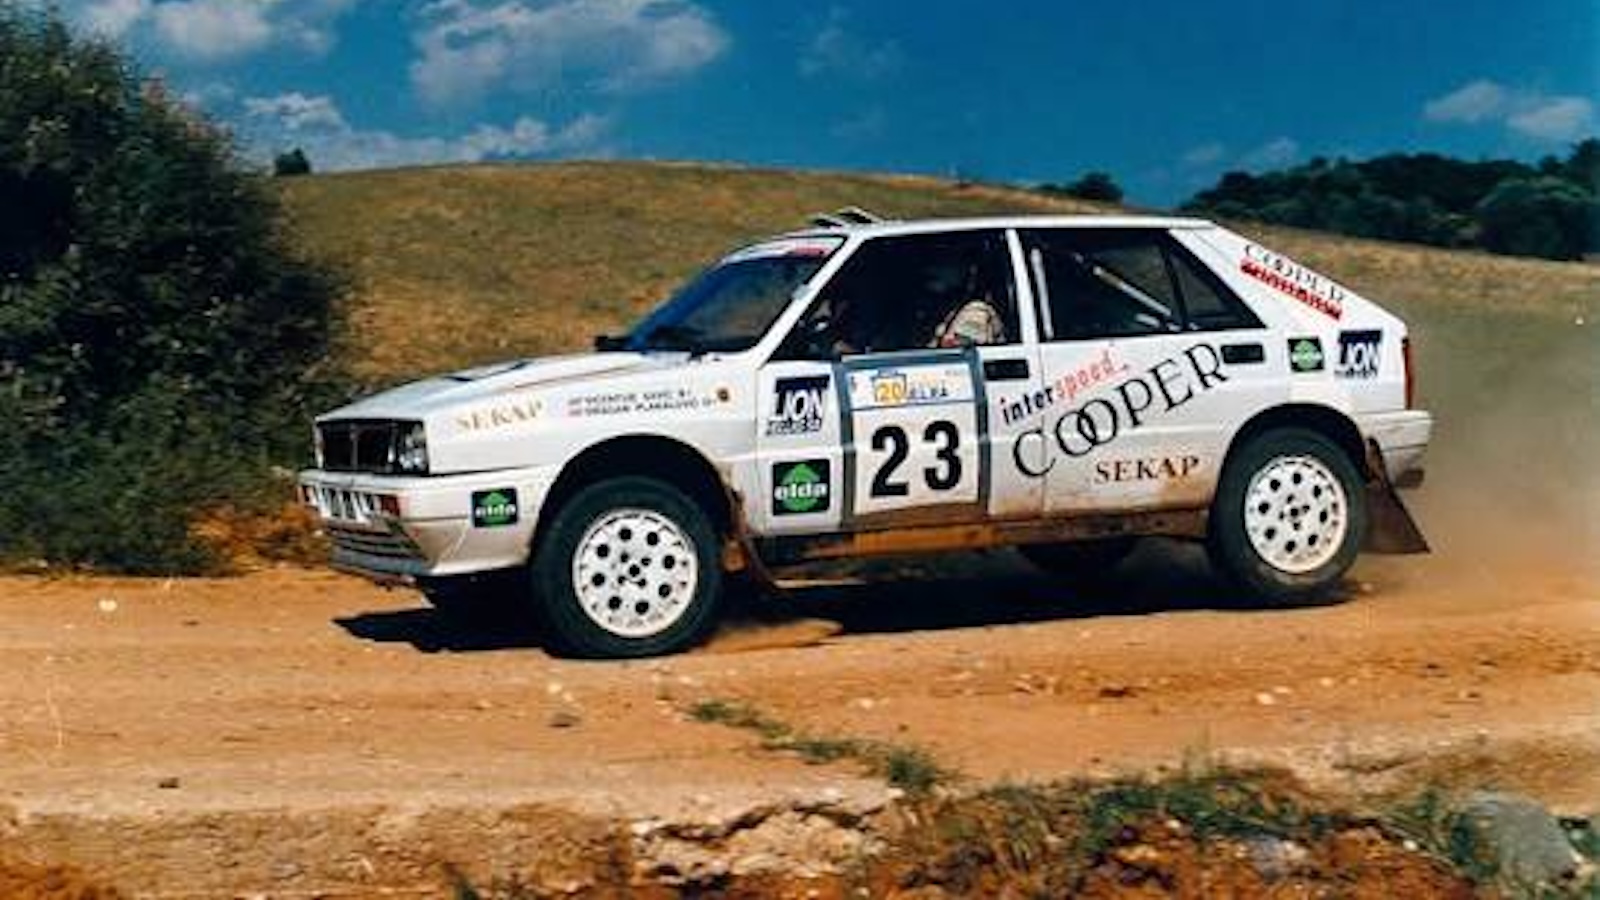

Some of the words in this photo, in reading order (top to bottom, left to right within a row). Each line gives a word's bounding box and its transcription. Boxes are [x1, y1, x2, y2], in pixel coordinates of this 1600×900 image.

[1000, 350, 1116, 426] interspeed
[1012, 343, 1230, 478] COOPER
[455, 400, 543, 430] SEKAP
[869, 419, 963, 498] 23
[1094, 455, 1200, 484] SEKAP
[773, 482, 828, 501] elda
